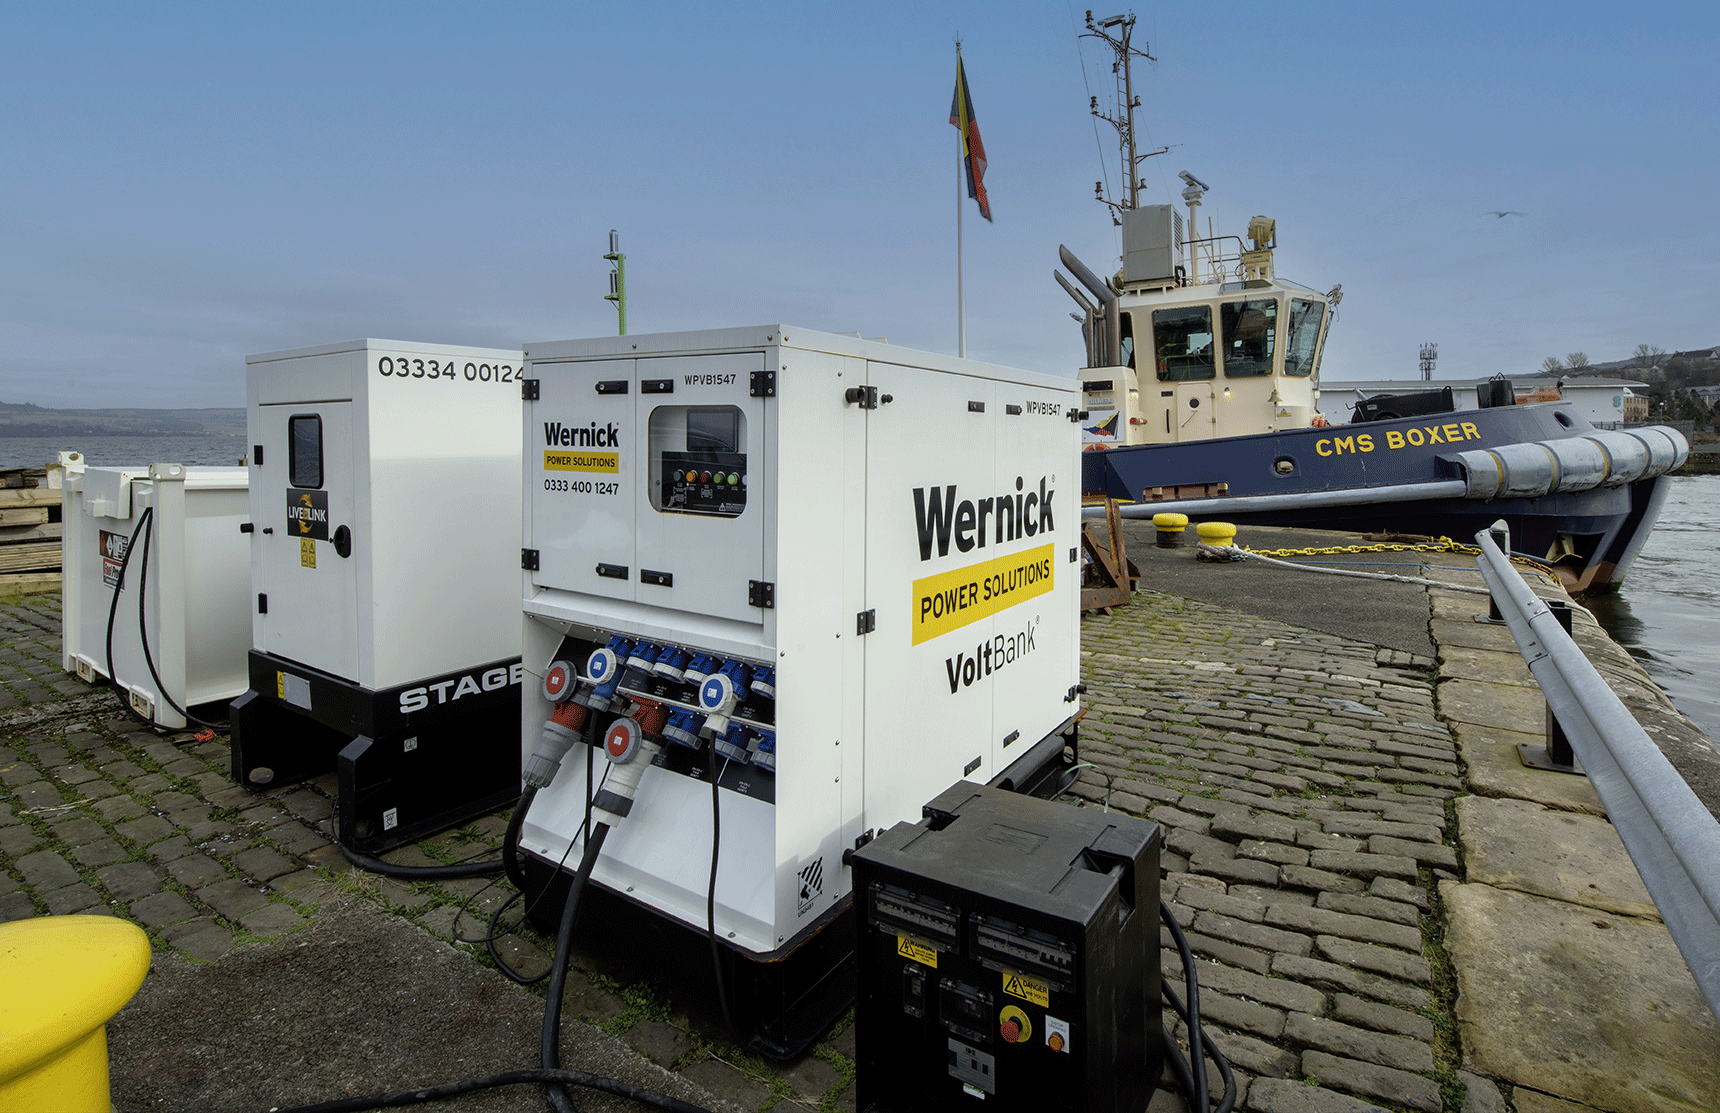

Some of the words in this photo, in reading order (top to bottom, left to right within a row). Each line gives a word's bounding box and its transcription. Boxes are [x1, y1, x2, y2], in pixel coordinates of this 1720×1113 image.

[378, 356, 456, 380] 03334
[684, 373, 737, 386] WPVB1547
[1026, 400, 1061, 416] WPVB1547
[543, 421, 619, 448] Wernick
[1315, 433, 1375, 457] CMS
[1385, 421, 1482, 450] BOXER
[546, 455, 572, 466] POWER
[573, 456, 616, 468] SOLUTIONS
[544, 479, 569, 492] 0333
[571, 481, 592, 494] 400
[594, 482, 619, 495] 1247
[912, 475, 1055, 562] Wernick
[920, 582, 979, 624] POWER
[983, 558, 1050, 601] SOLUTIONS
[945, 620, 1036, 695] VoltBank
[1023, 980, 1048, 994] DANGER
